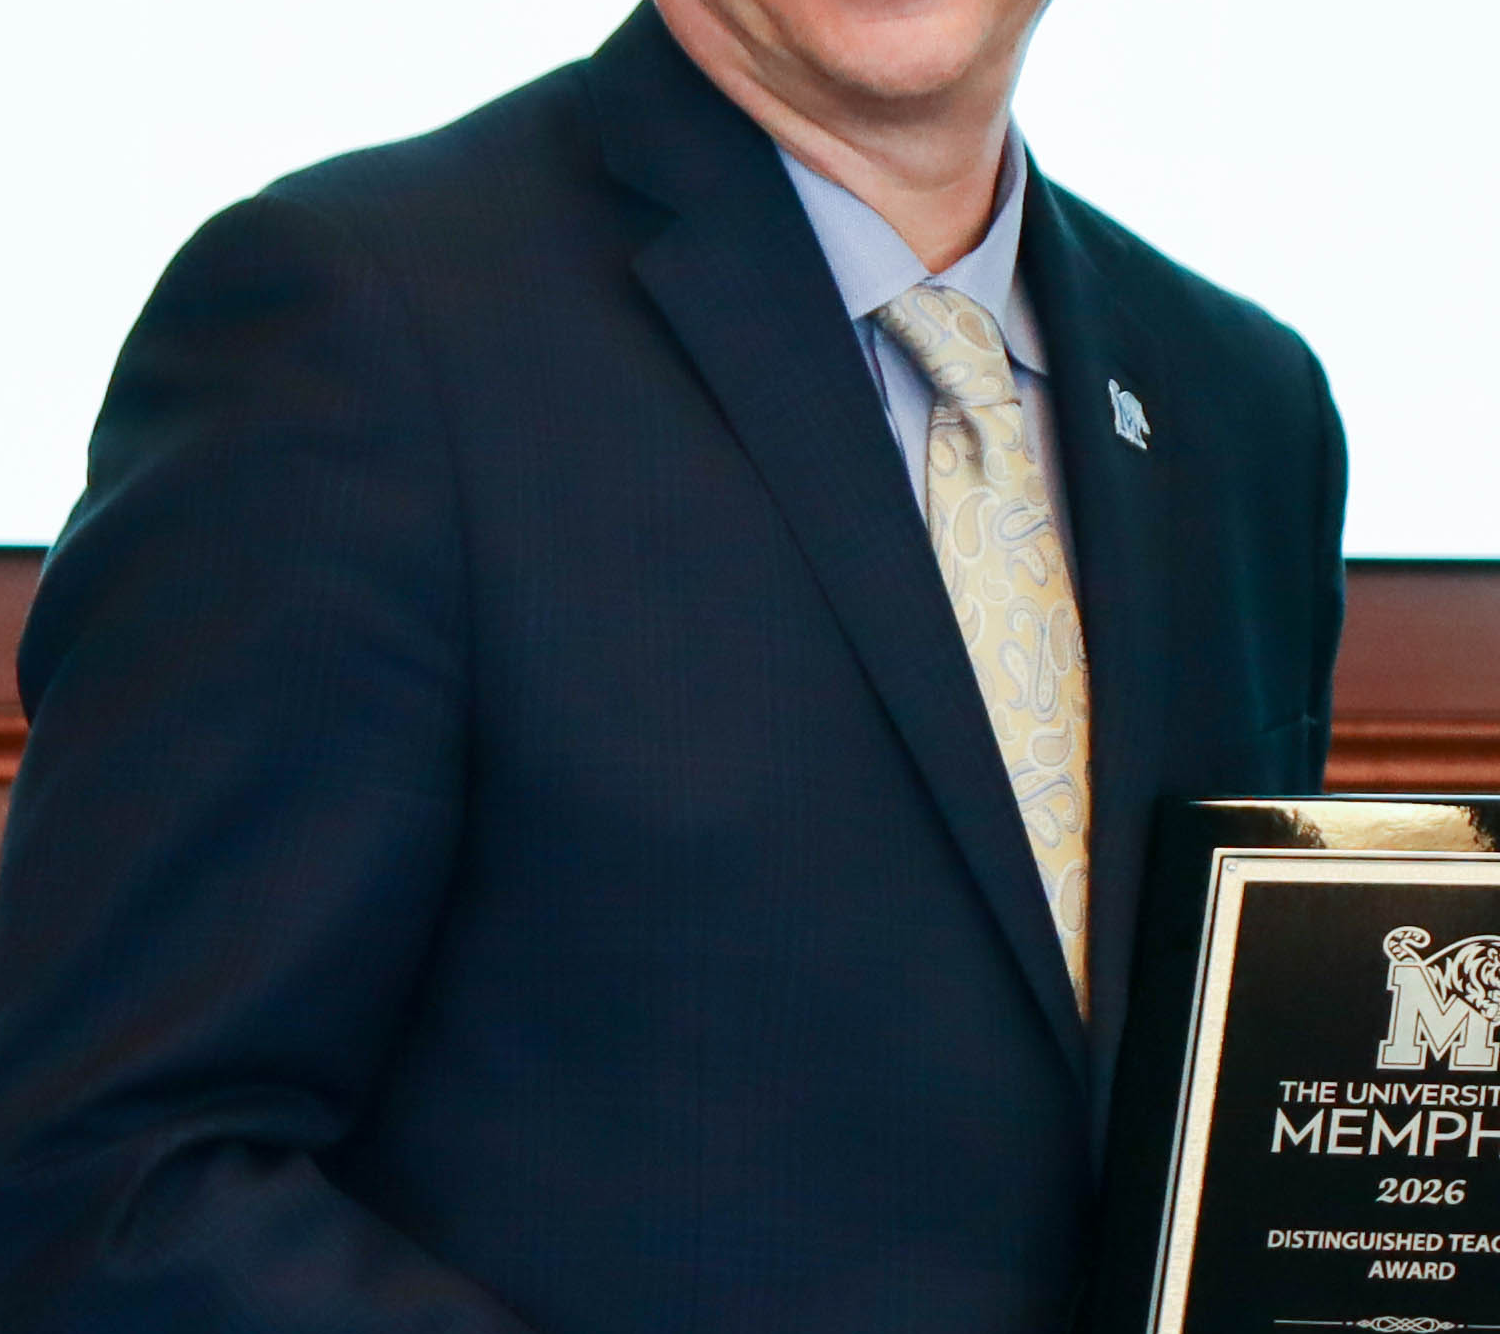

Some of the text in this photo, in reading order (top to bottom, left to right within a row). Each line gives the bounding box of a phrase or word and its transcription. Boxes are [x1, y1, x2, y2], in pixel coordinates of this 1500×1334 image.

[1279, 1080, 1338, 1104] THE
[1375, 1176, 1468, 1206] 2026
[1266, 1229, 1443, 1253] DISTINGUISHED
[1367, 1259, 1456, 1281] AWARD
